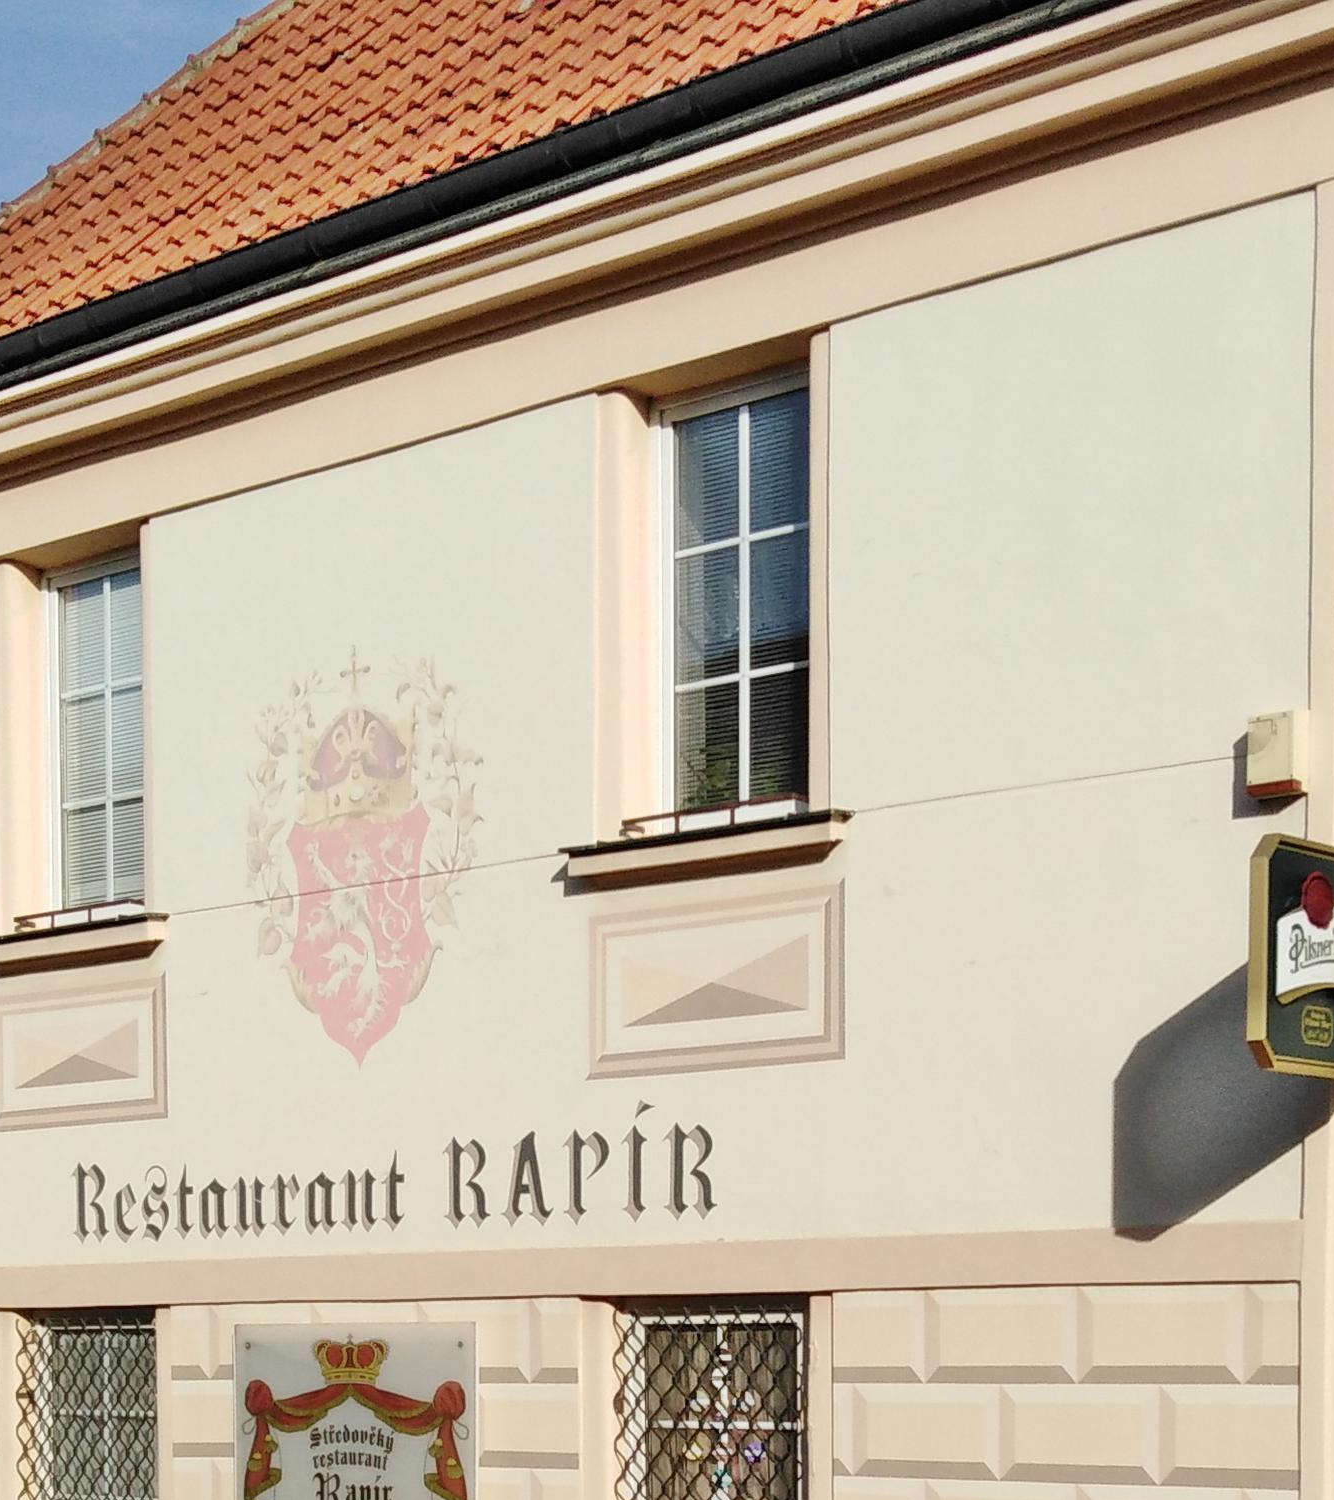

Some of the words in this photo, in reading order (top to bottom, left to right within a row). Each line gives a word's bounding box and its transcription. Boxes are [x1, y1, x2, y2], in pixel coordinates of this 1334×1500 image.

[1288, 923, 1333, 974] Pilsner
[69, 1149, 406, 1244] Restaurant
[442, 1100, 718, 1229] RAPÍR
[309, 1424, 394, 1454] Středověký
[312, 1449, 389, 1471] restaurant
